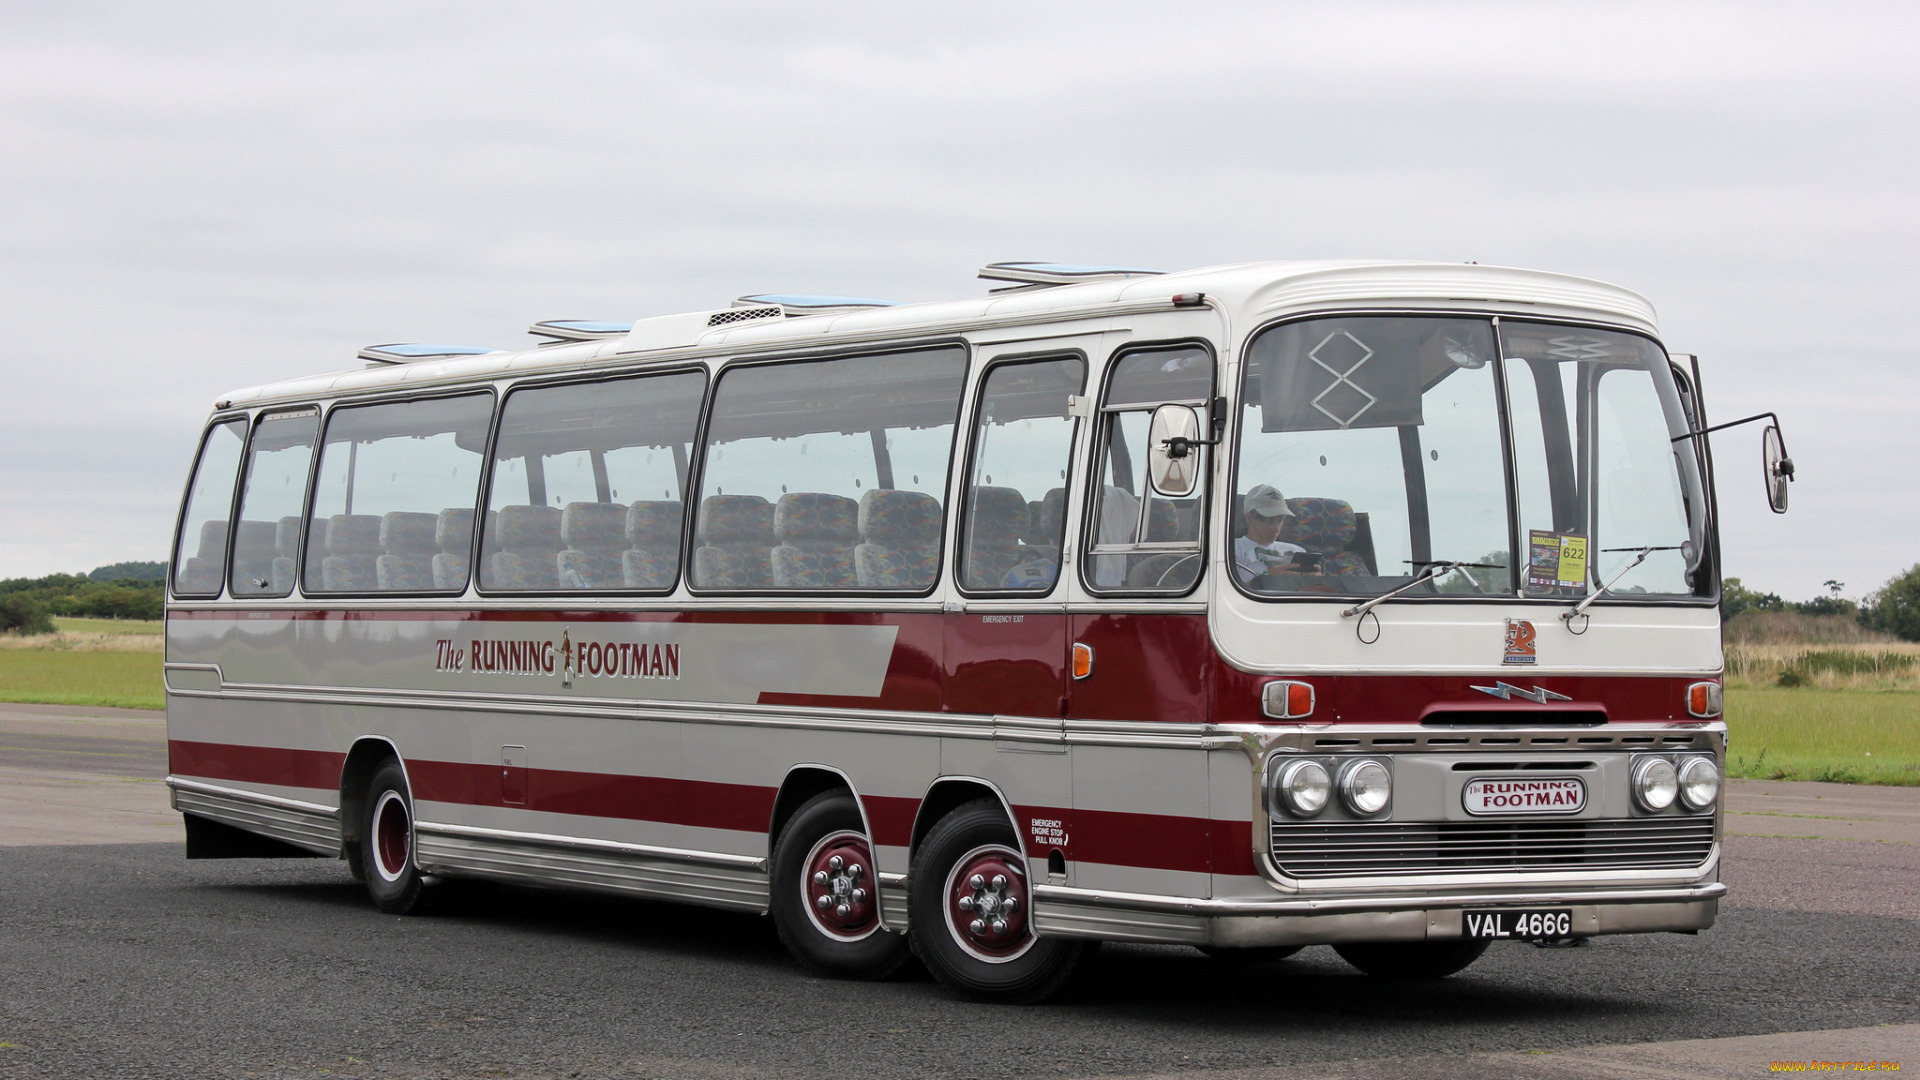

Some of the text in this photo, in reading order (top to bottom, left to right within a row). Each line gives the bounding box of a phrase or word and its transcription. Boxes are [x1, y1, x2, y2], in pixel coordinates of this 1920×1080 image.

[1563, 547, 1585, 560] 622
[982, 615, 1024, 624] EMERGENCY EXIT
[436, 638, 681, 680] The RUNNING FOOTMAN
[1469, 782, 1577, 795] The RUNNING
[1483, 790, 1578, 807] FOOTMAN
[1031, 818, 1062, 828] EMERGENCY
[1031, 827, 1064, 837] ENGINE STOP
[1035, 835, 1063, 846] PULL KNOB
[1467, 912, 1570, 937] VAL 466G
